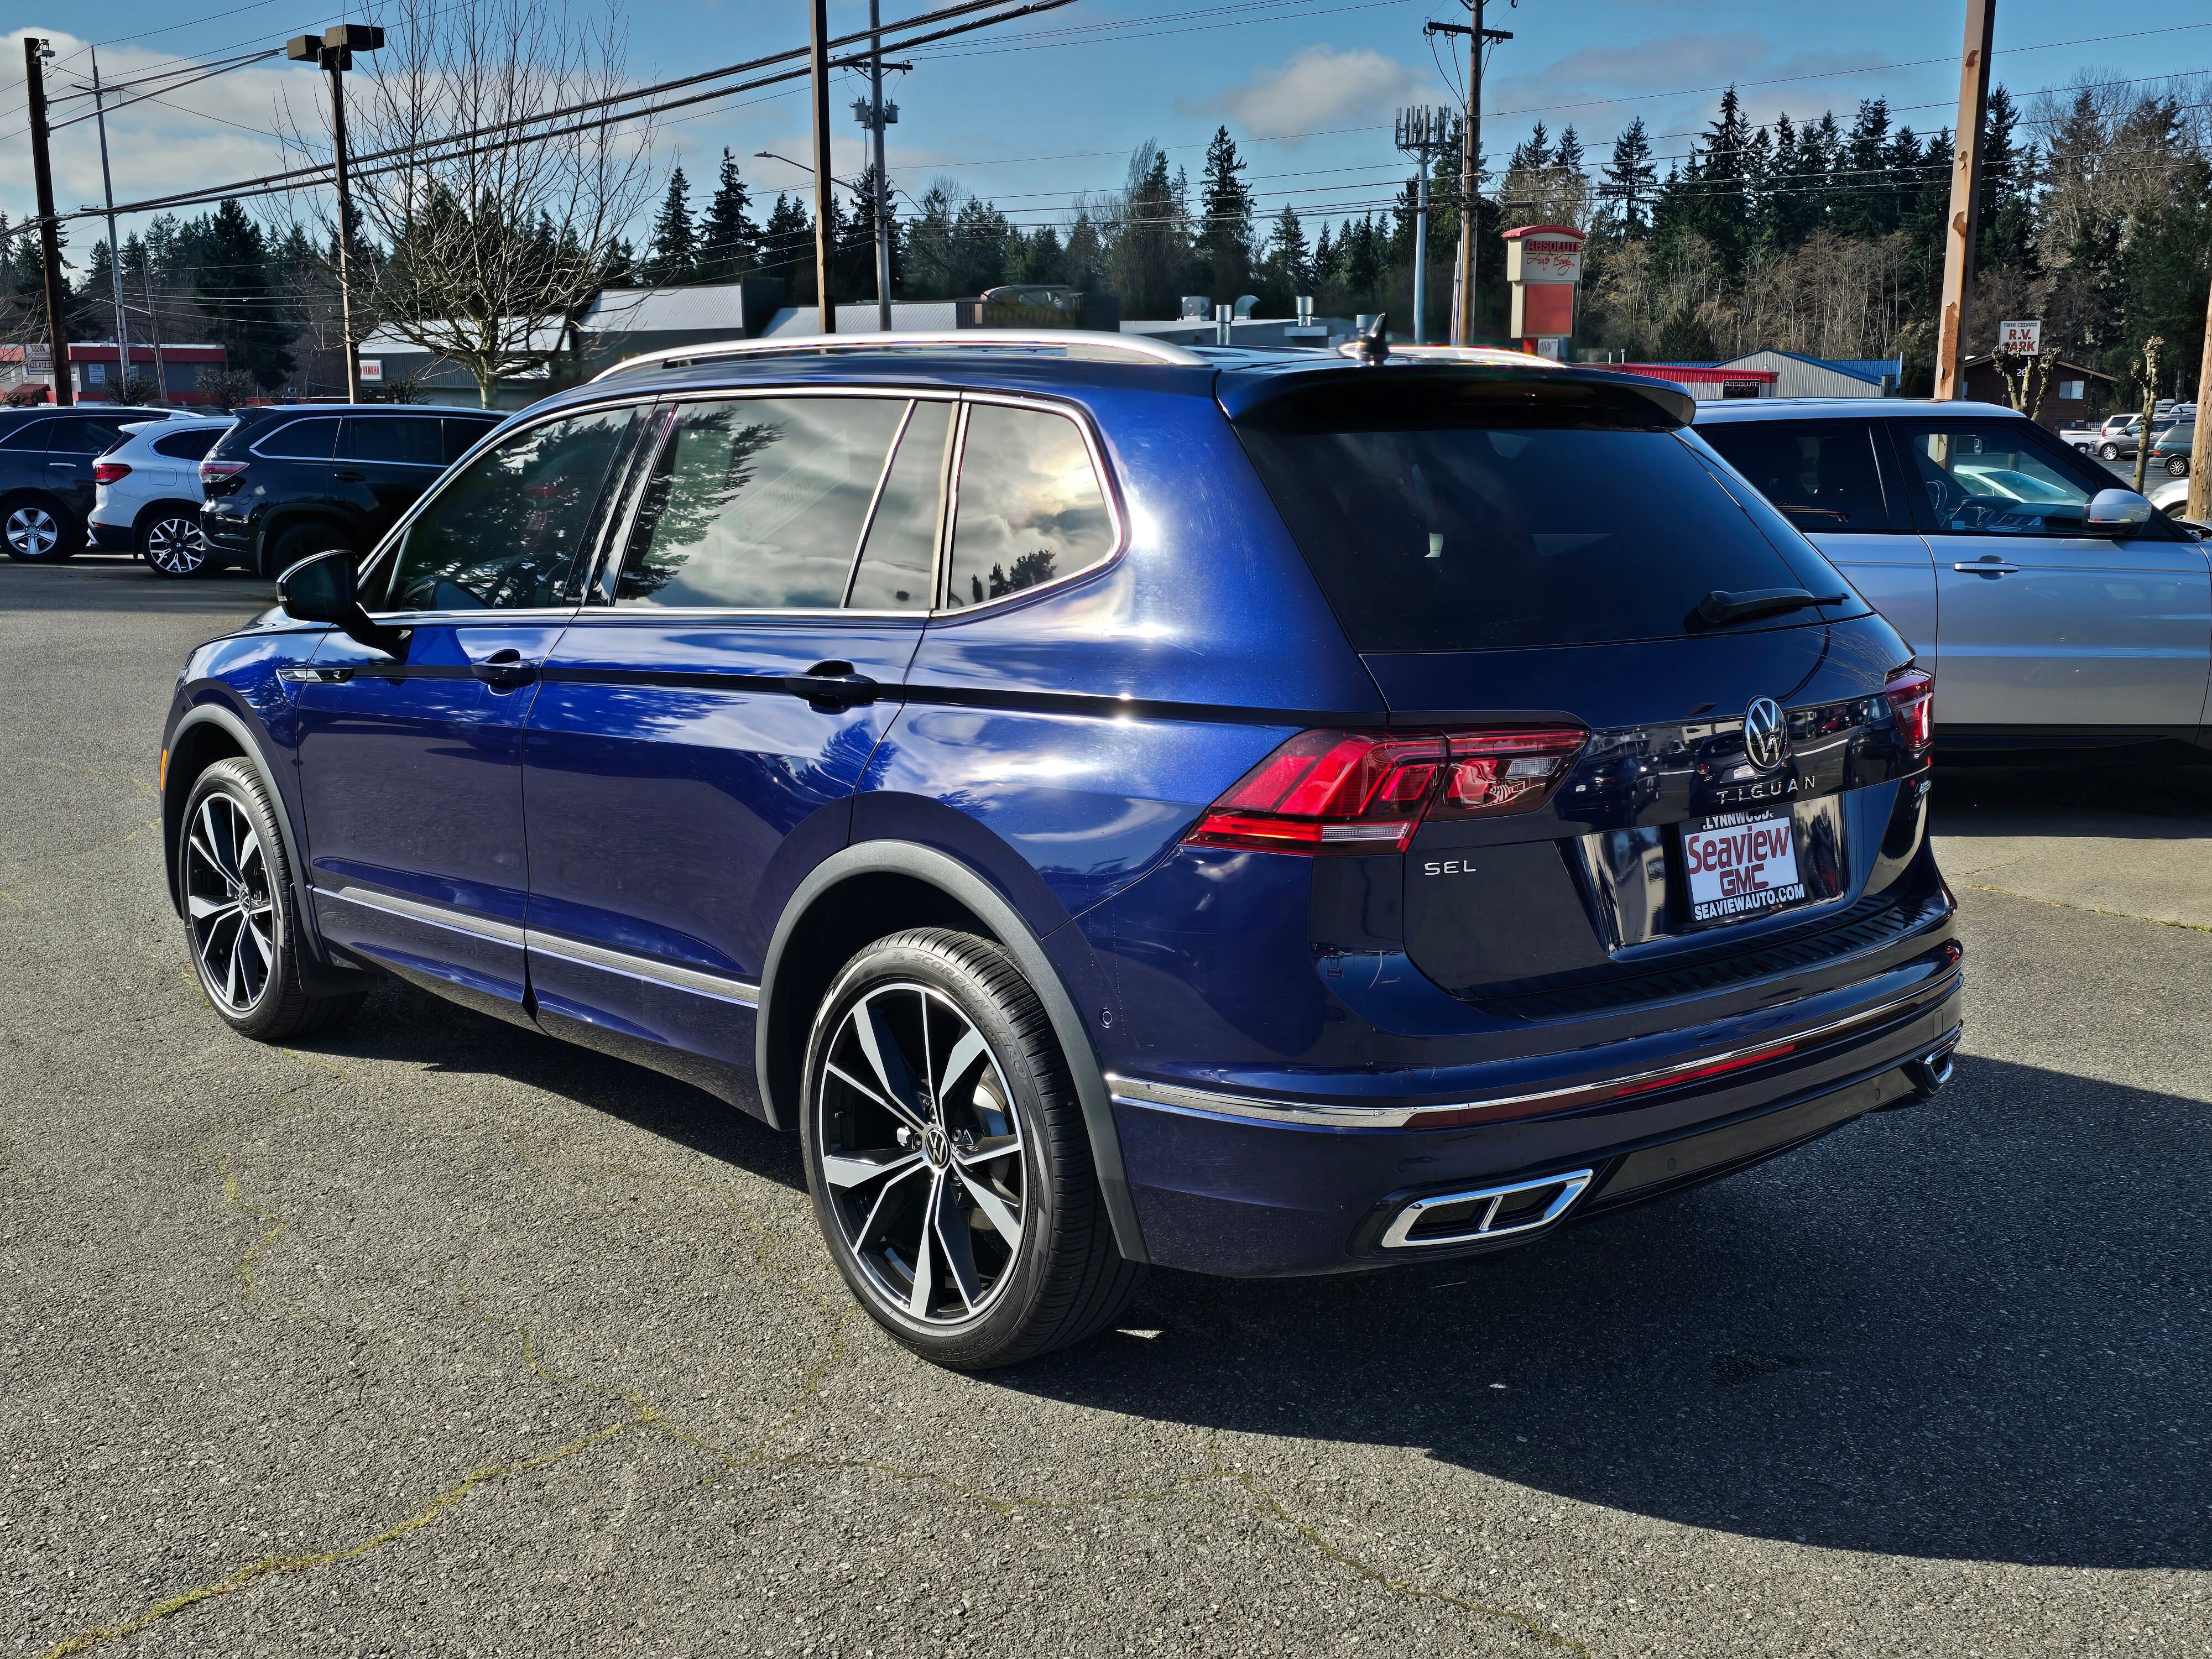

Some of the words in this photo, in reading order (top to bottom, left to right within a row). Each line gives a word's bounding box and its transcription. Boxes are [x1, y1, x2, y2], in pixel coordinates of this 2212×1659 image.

[1525, 238, 1582, 252] ABSOLUTE
[2008, 328, 2031, 340] R.V.
[2008, 341, 2036, 352] ARK
[1717, 775, 1815, 804] TIGUAN
[1688, 825, 1790, 875] Seaview
[1424, 860, 1477, 875] SEL
[1719, 863, 1769, 897] GMC
[1694, 884, 1805, 921] SEAVIEWAUTO.COM
[911, 953, 992, 1011] SCORPION
